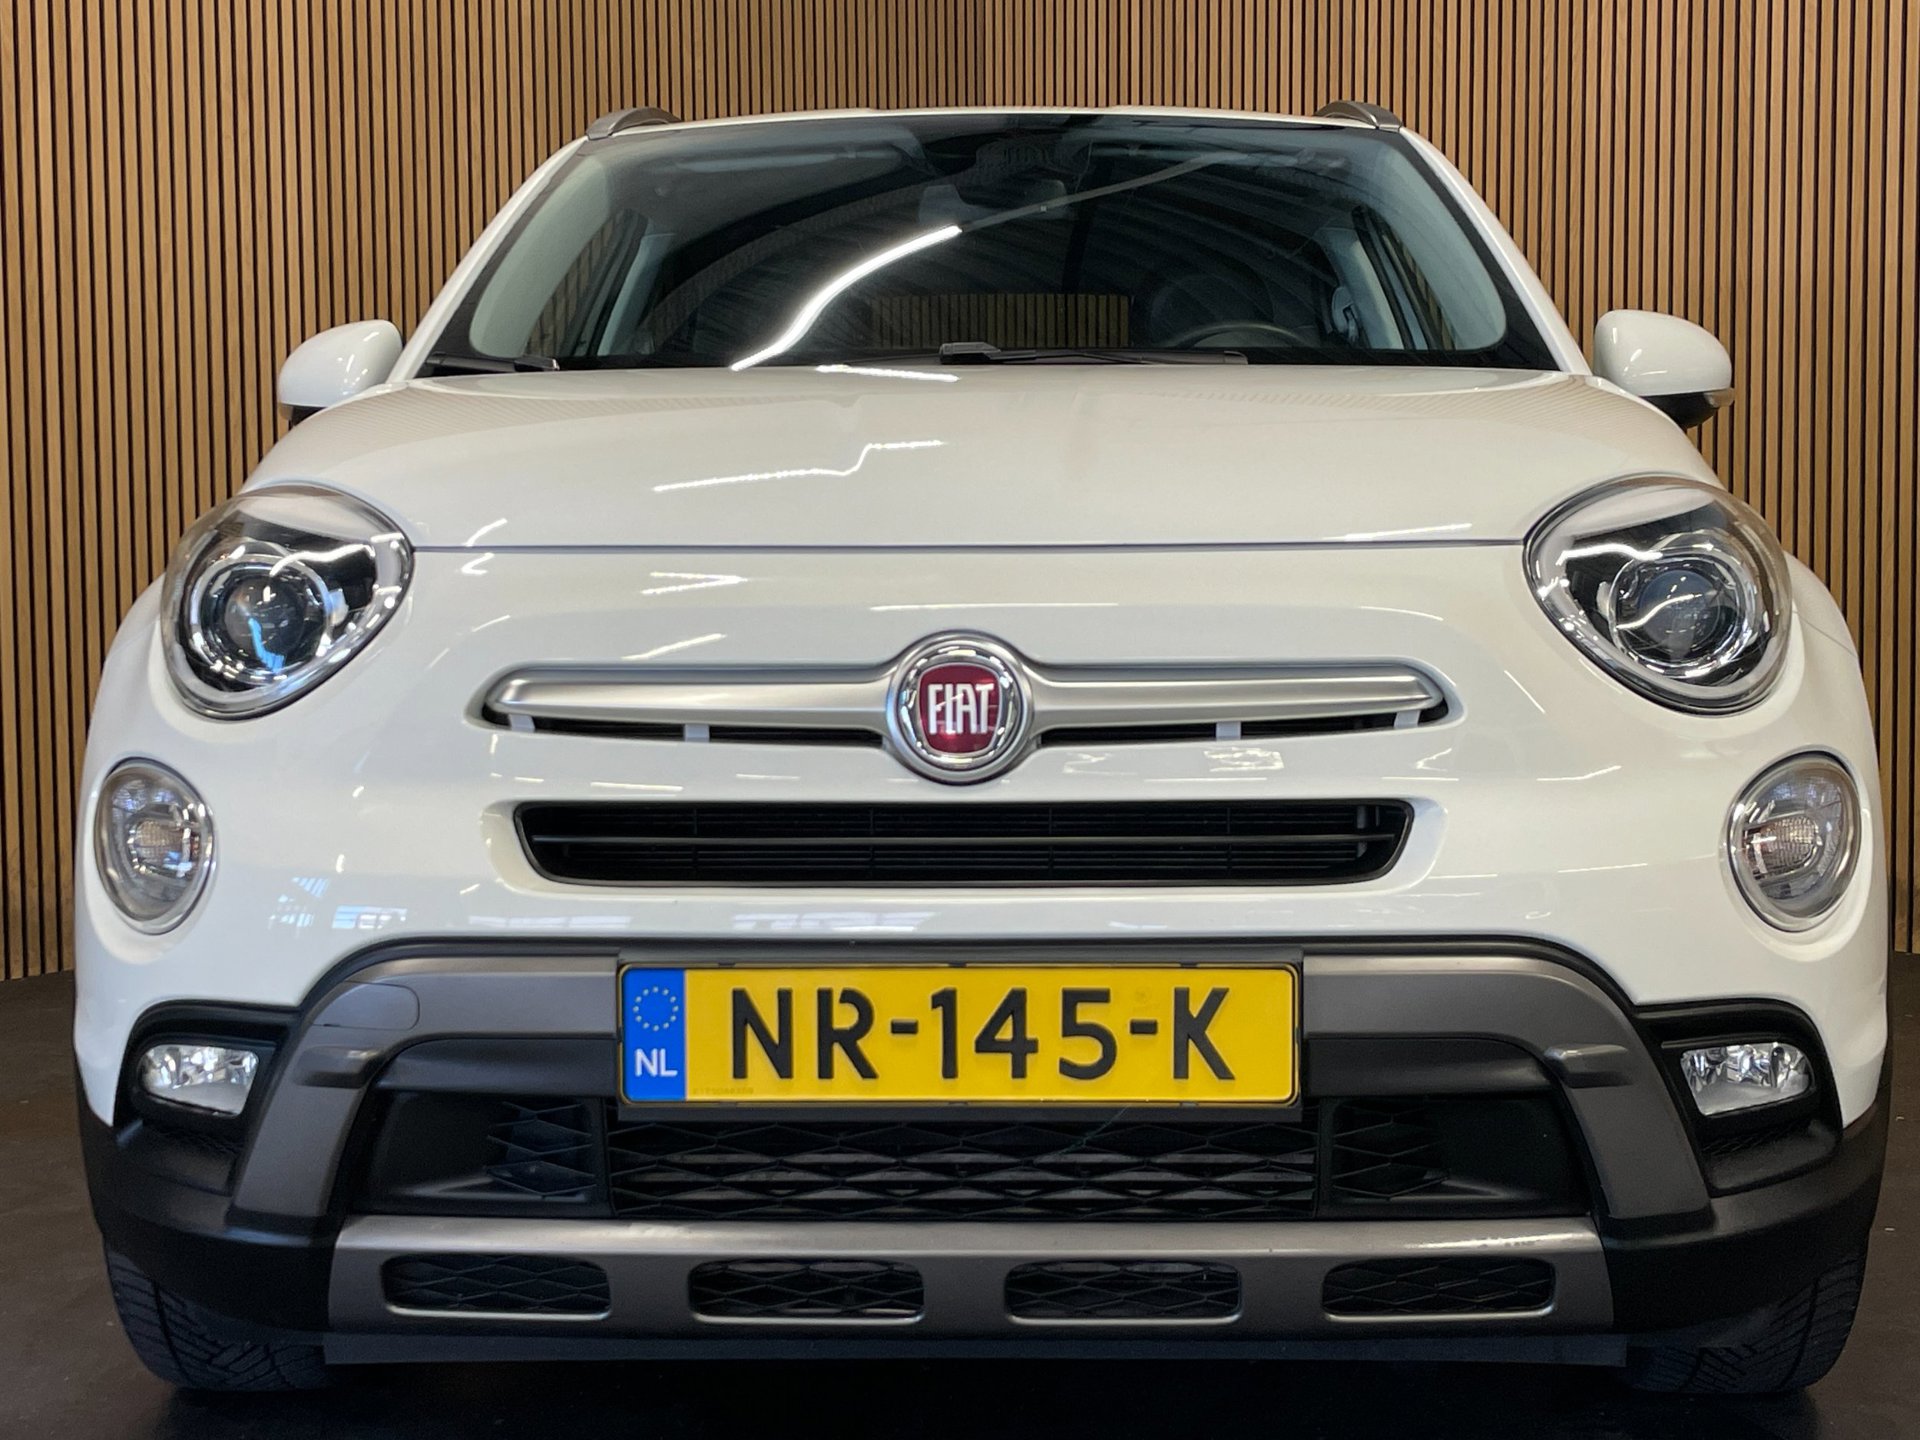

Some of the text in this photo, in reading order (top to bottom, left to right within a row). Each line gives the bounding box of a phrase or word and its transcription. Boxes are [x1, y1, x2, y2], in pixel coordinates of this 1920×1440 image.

[927, 683, 995, 736] FIAT
[731, 986, 1236, 1081] NR-145-K
[634, 1048, 679, 1078] NL
